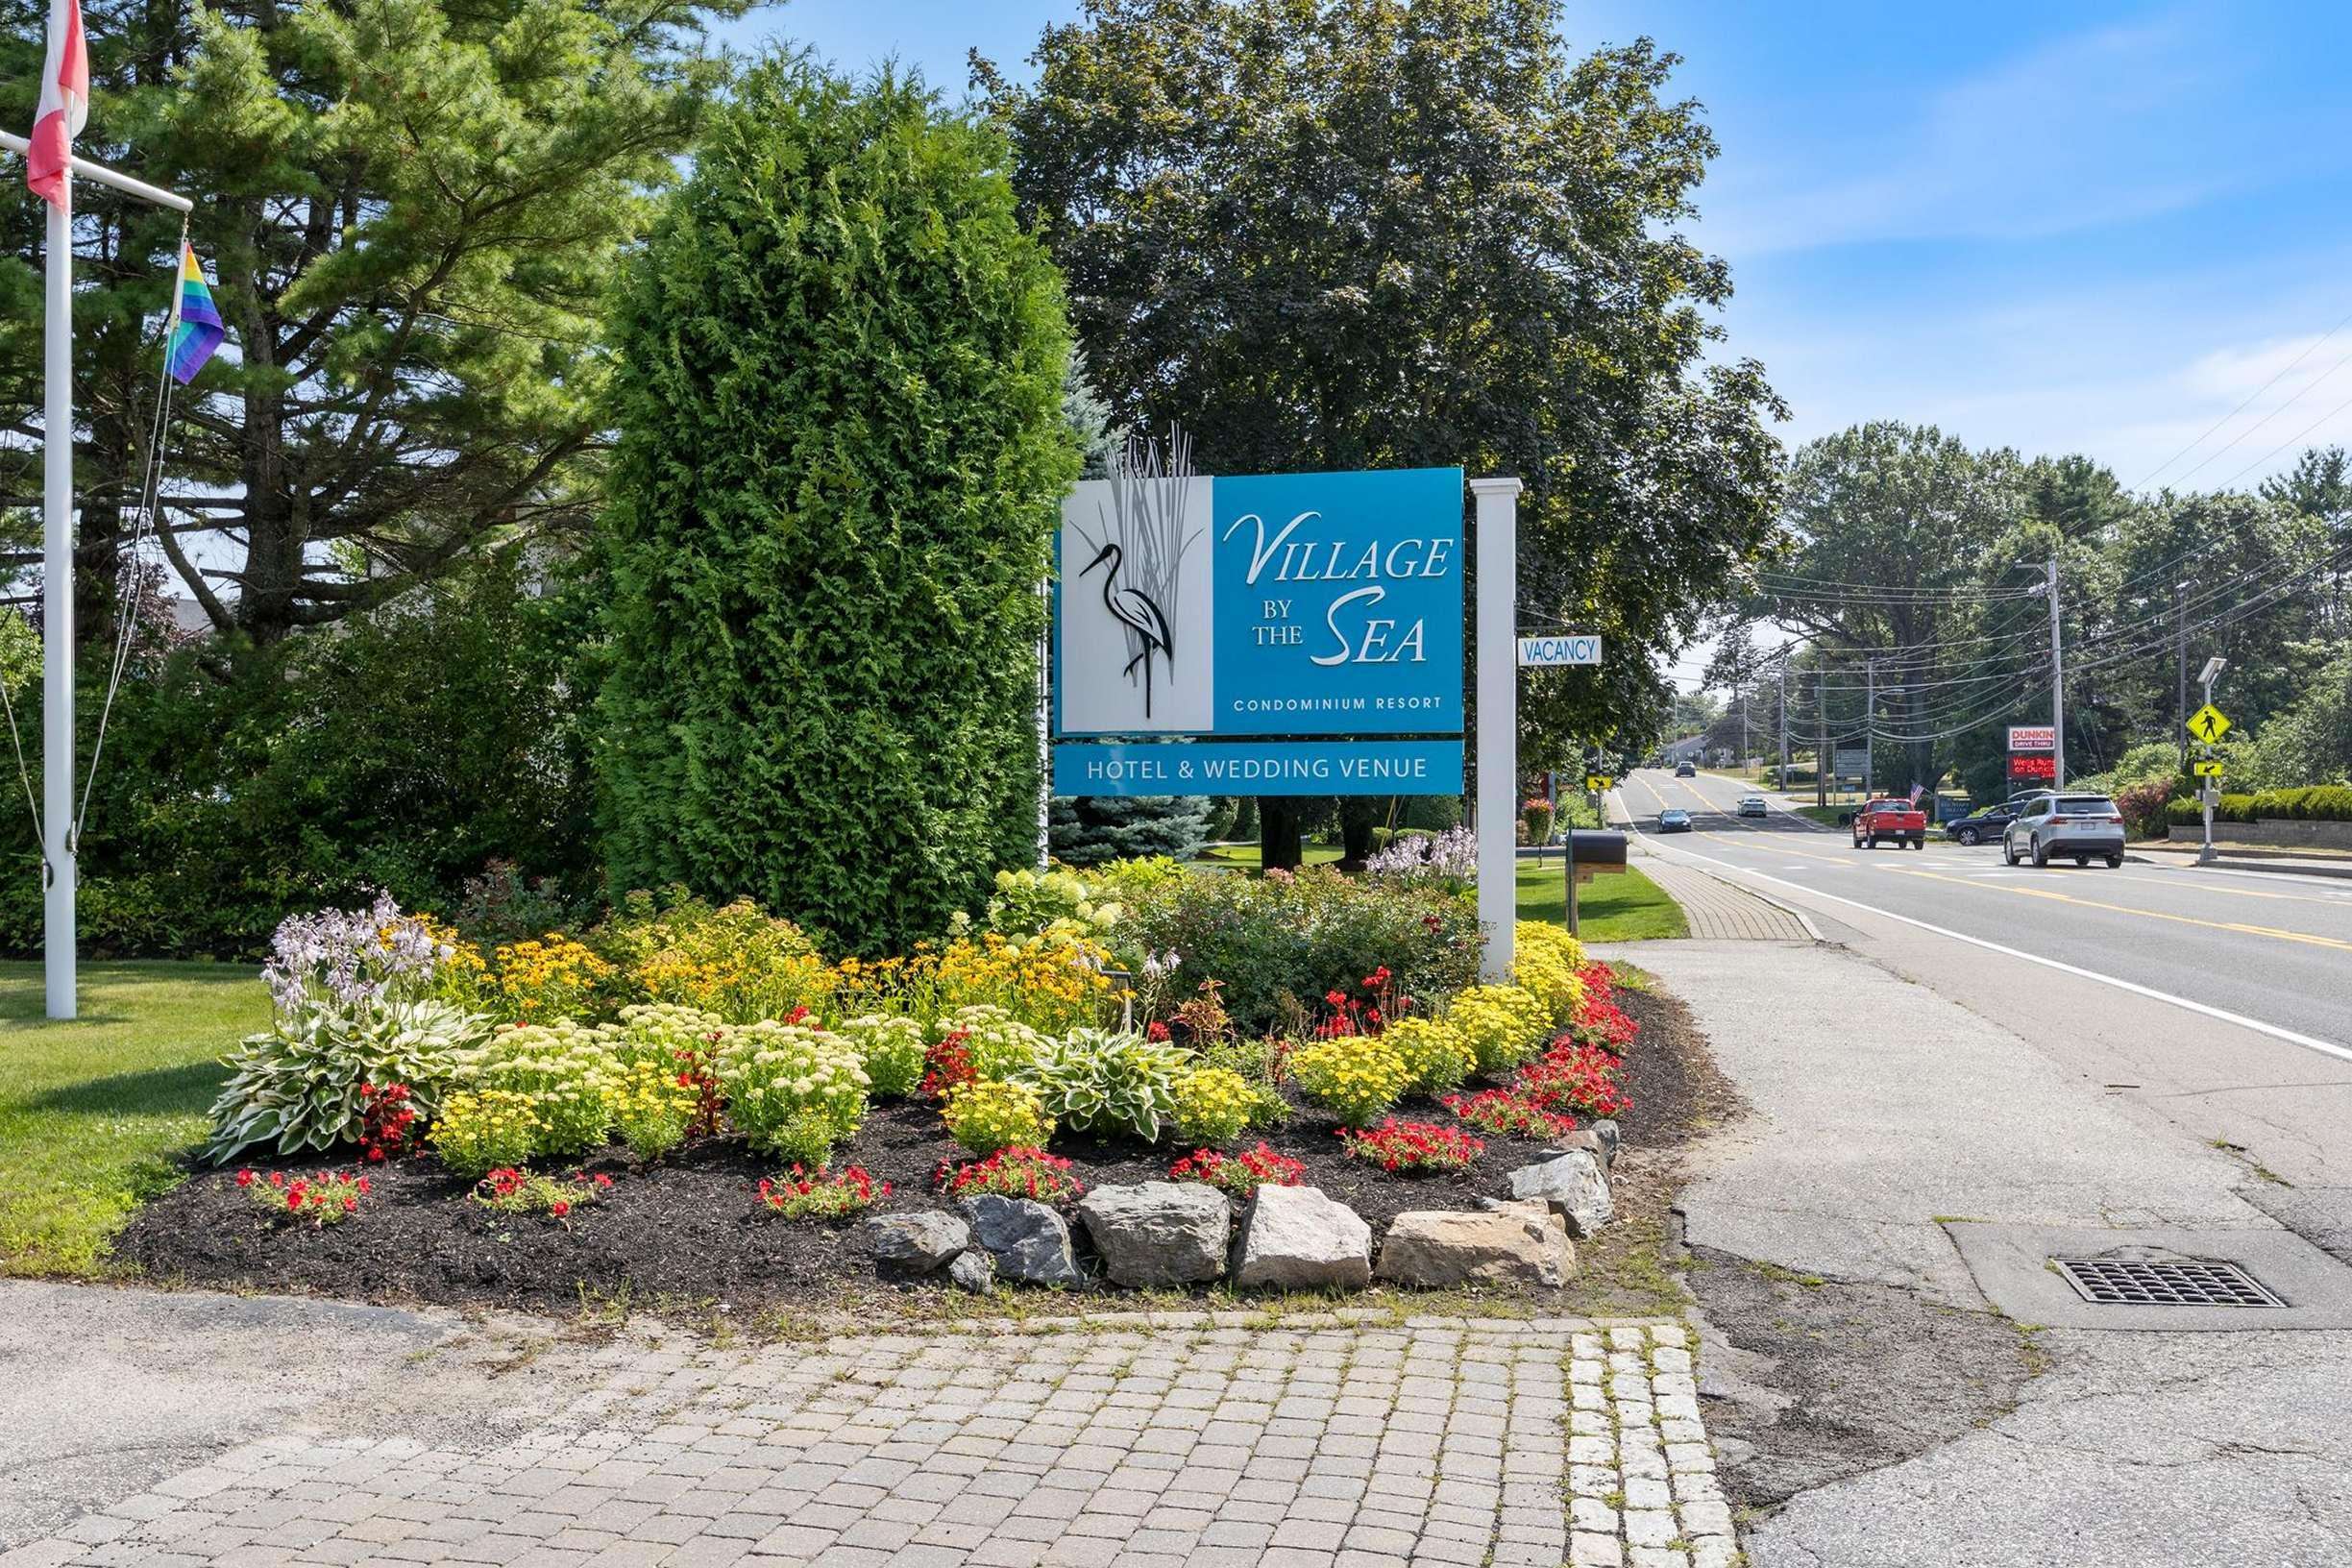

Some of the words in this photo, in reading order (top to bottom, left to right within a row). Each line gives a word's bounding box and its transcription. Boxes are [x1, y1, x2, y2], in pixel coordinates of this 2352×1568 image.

[1223, 511, 1454, 584] VILLAGE
[1262, 600, 1292, 619] BY
[1252, 625, 1304, 646] THE
[1310, 585, 1427, 665] SEA
[1524, 639, 1596, 661] VACANCY
[1234, 698, 1365, 712] CONDOMINIUM
[1376, 697, 1442, 709] RESORT
[1088, 760, 1167, 779] HOTEL
[1178, 760, 1194, 779] &
[1204, 759, 1330, 779] WEDDING
[1339, 758, 1427, 778] VENUE
